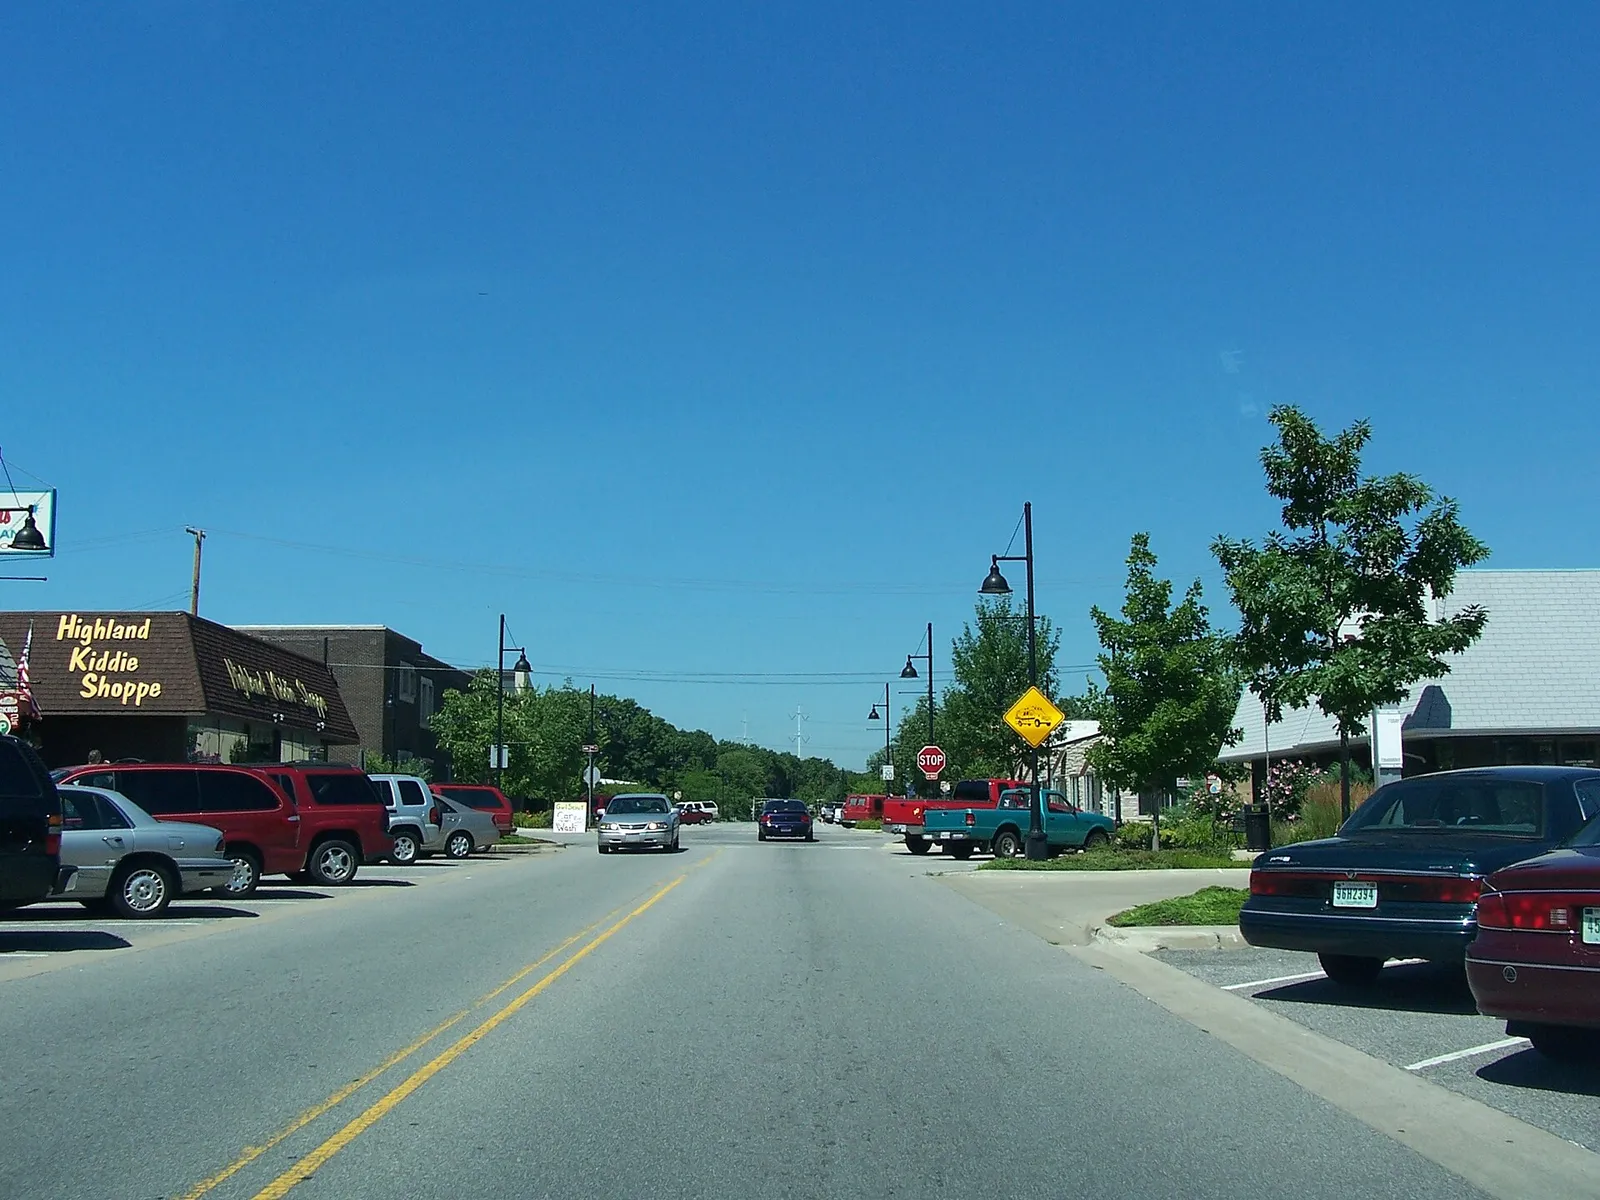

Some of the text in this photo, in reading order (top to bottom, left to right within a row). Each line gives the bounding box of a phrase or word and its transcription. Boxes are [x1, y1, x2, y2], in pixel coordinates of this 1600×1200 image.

[56, 614, 151, 646] Highland
[68, 646, 139, 672] Kiddie
[79, 672, 161, 706] Shoppe
[919, 754, 944, 766] STOP
